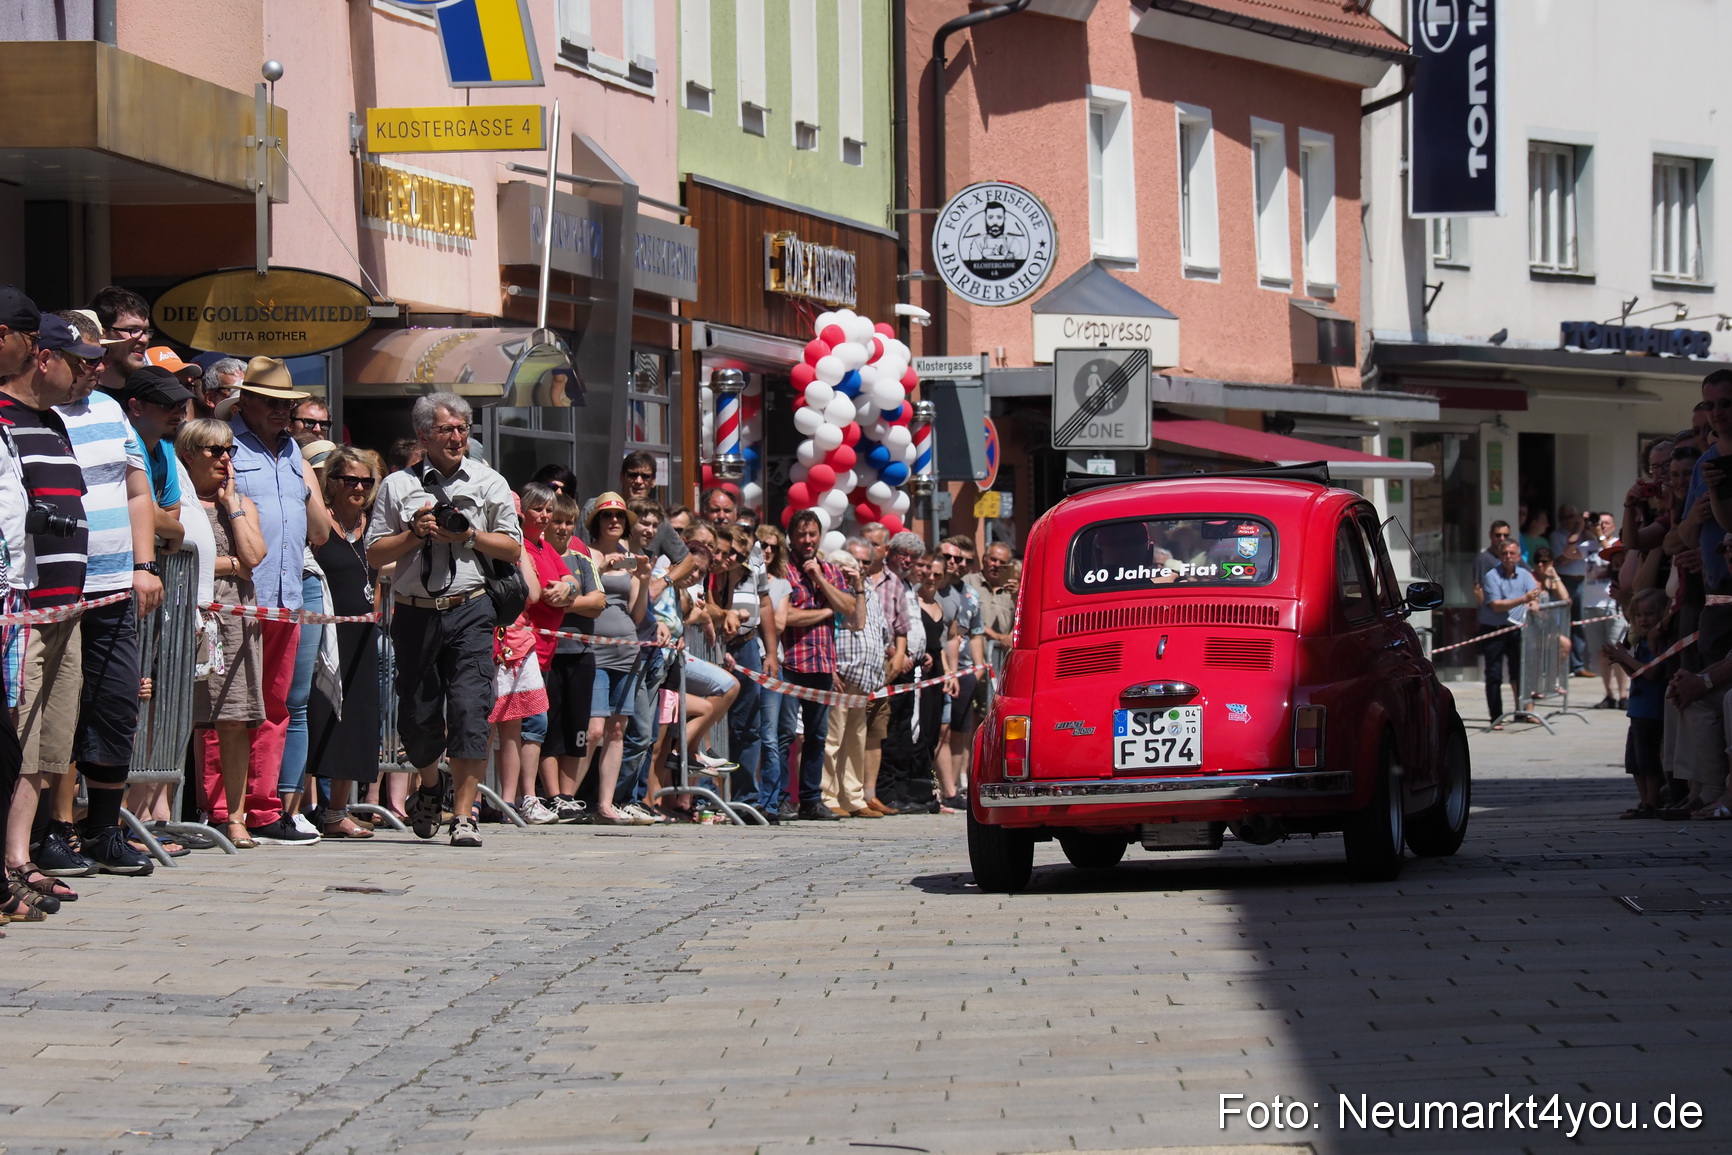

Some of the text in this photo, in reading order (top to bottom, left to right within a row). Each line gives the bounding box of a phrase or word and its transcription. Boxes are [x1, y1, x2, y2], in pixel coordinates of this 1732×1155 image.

[1467, 44, 1489, 178] TOM
[376, 118, 531, 138] KLOSTERGASSE 4
[985, 190, 1044, 230] FRISEURE
[942, 250, 1047, 300] BARBERSHOP
[163, 305, 366, 322] DIE GOLDSCHMIEDE
[218, 331, 306, 341] JUTTA ROTHER
[1063, 317, 1152, 345] Creppresso
[916, 360, 973, 373] Klostergasse
[1078, 423, 1124, 438] ZONE
[1084, 562, 1257, 584] 60 Jahre Fiat 500
[1118, 726, 1124, 734] D
[1131, 711, 1166, 736] SC
[1121, 737, 1194, 765] F 574
